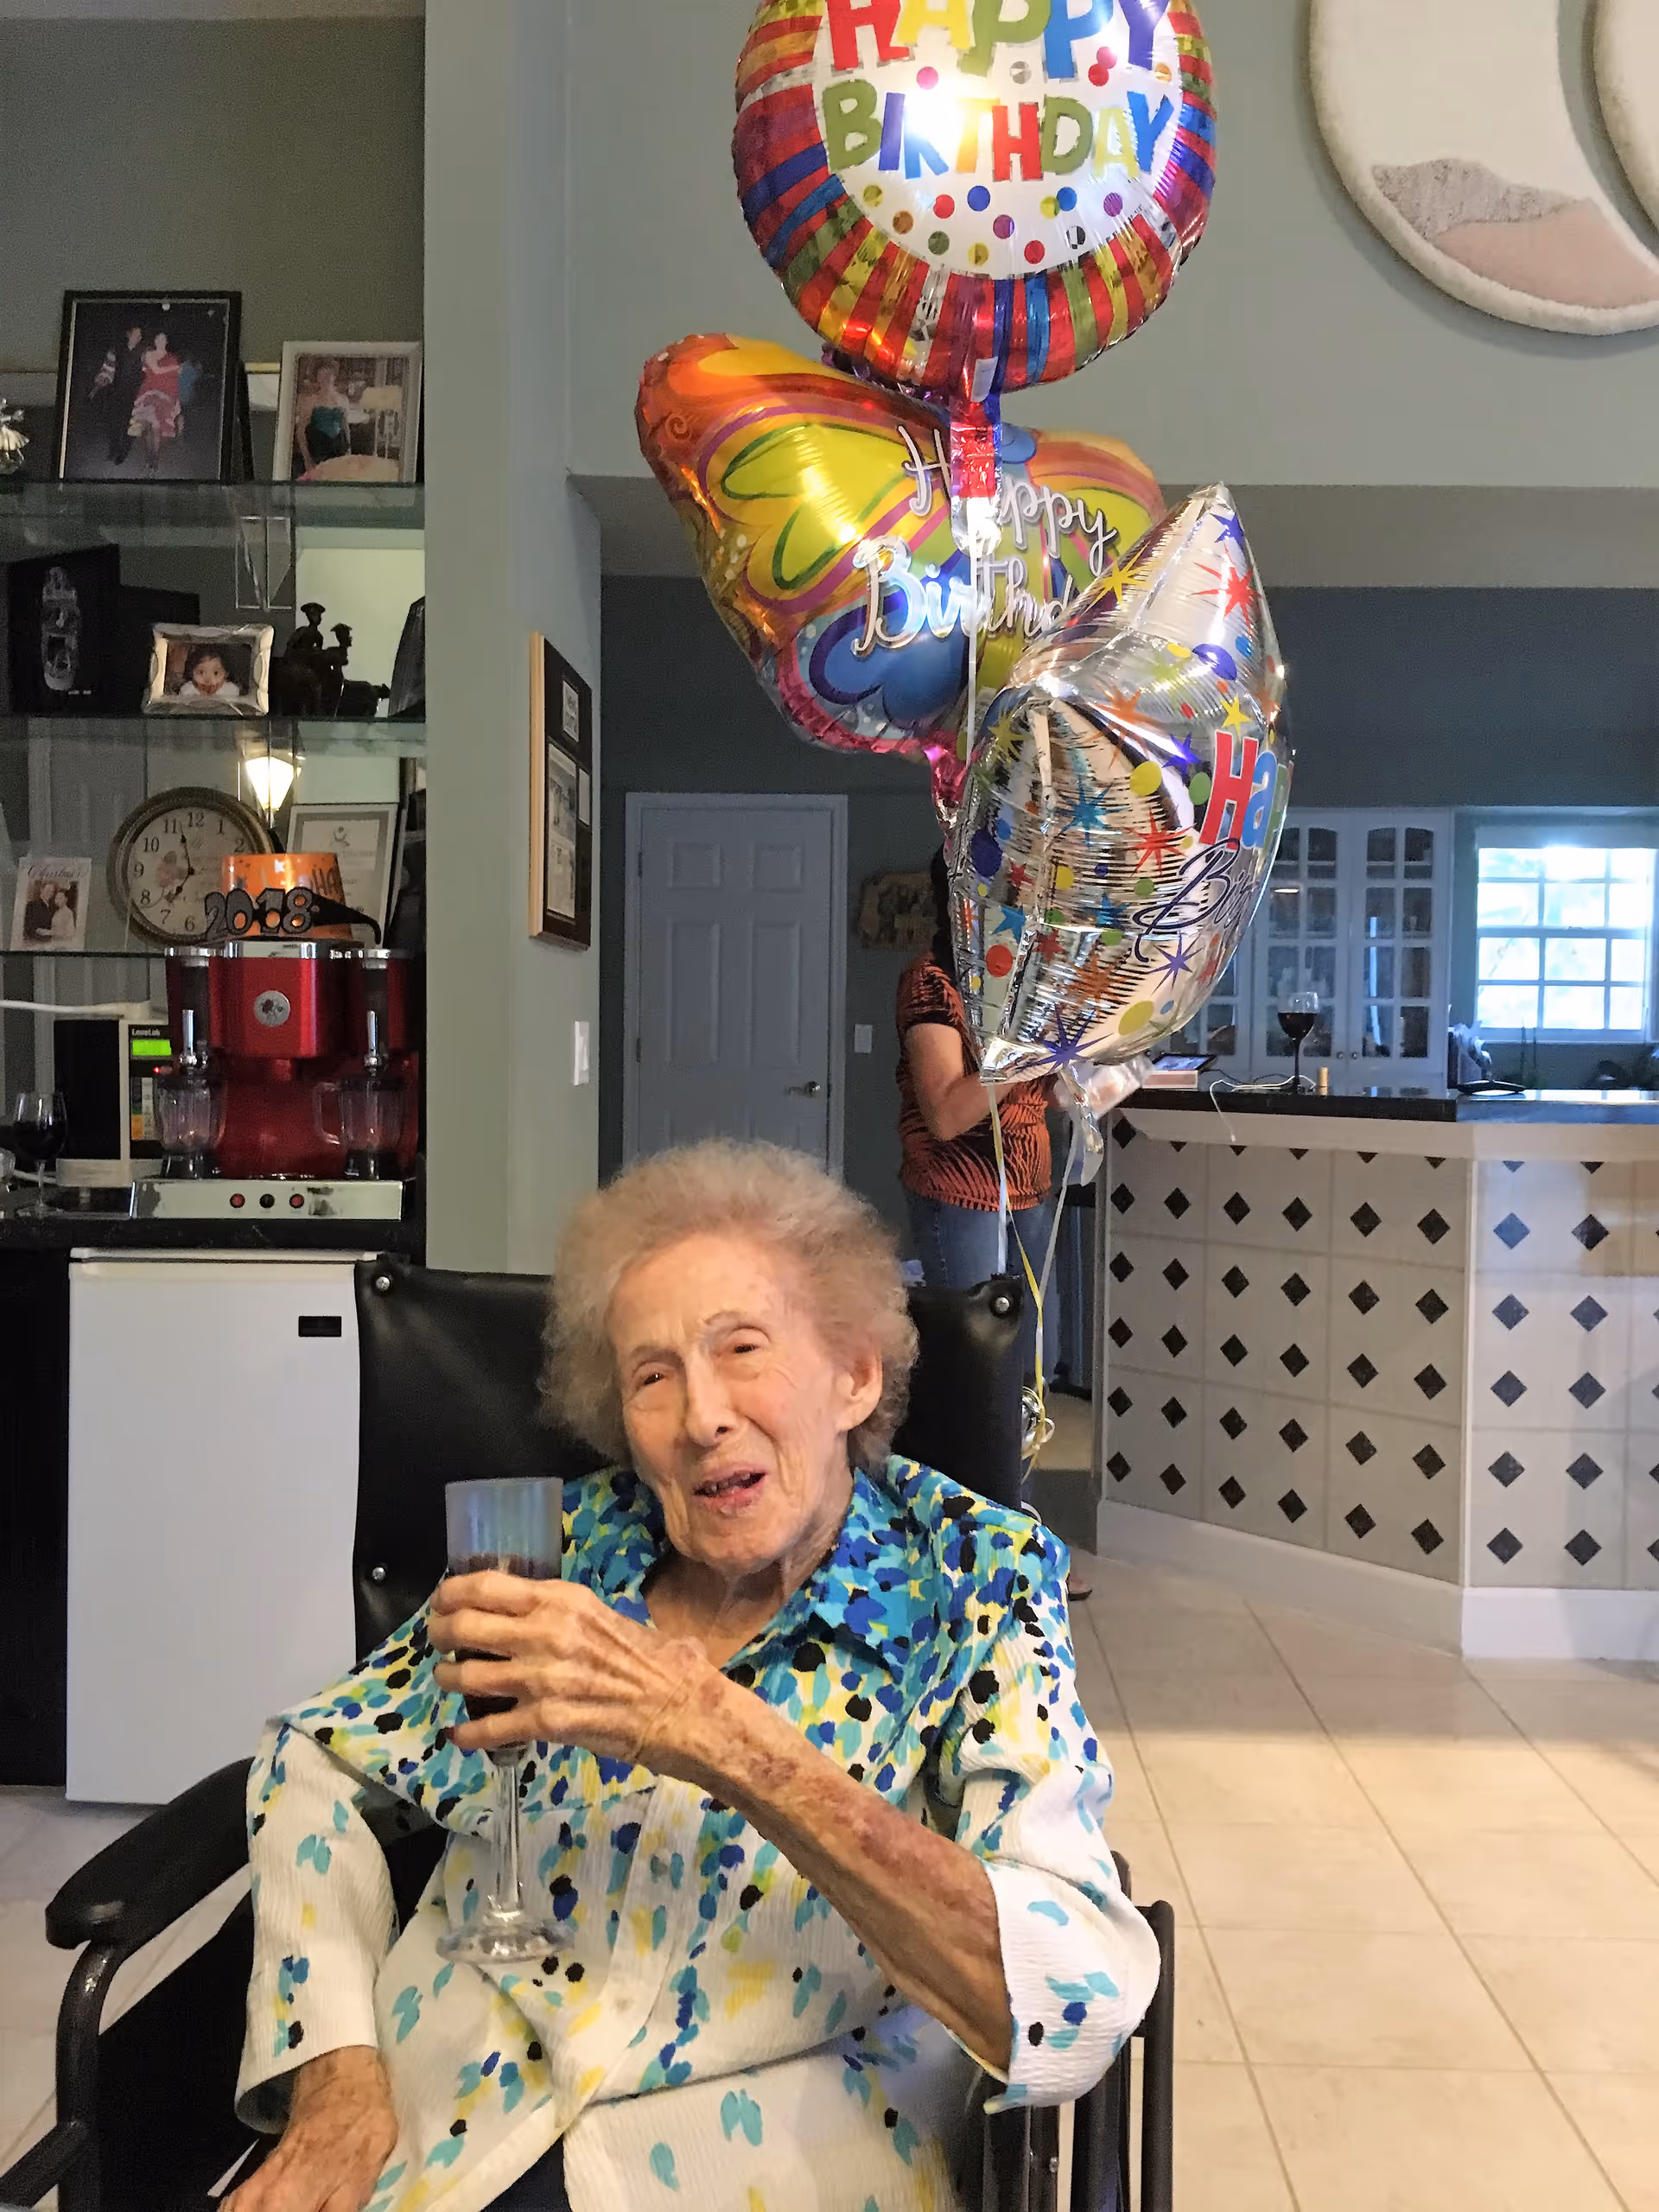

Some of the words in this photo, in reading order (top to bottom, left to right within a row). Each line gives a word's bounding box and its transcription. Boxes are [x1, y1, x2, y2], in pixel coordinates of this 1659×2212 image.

[899, 424, 1120, 577] Hppy
[163, 817, 178, 835] 11
[188, 811, 205, 828] 12
[218, 819, 225, 836] 1
[143, 836, 160, 853] 10
[234, 837, 245, 854] 2
[133, 861, 145, 877] 9
[140, 888, 151, 906] 8
[160, 908, 171, 925] 7
[204, 886, 313, 941] 2018
[184, 915, 195, 931] 6
